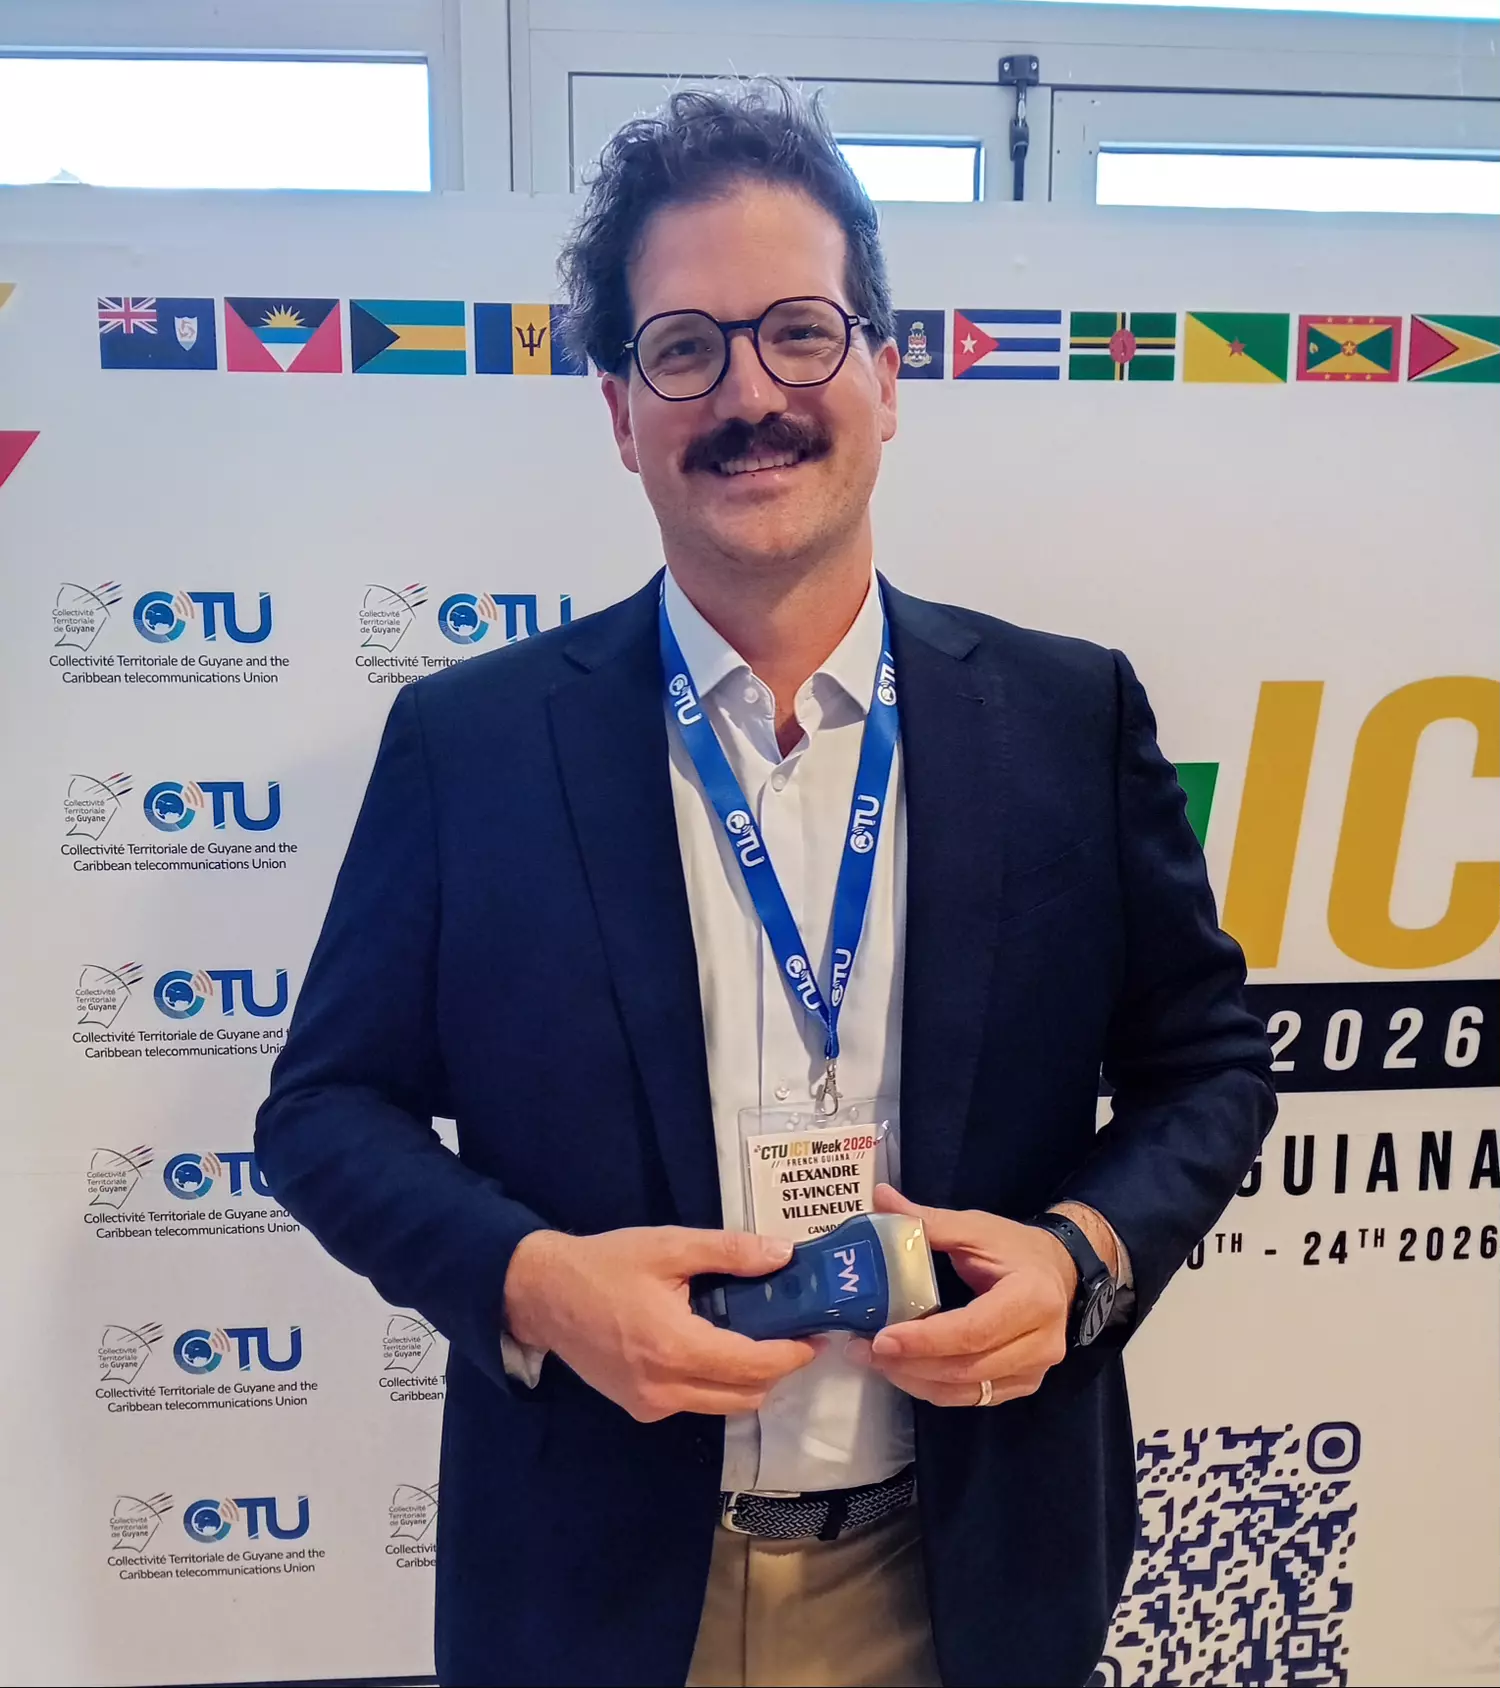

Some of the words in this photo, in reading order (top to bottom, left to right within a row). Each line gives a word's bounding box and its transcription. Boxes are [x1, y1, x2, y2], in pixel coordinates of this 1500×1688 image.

[133, 591, 272, 644] CTU
[54, 625, 63, 633] de
[66, 625, 95, 633] Guyane
[372, 626, 400, 635] Guyane
[50, 655, 114, 666] Collectivité
[117, 655, 177, 666] Territoriale
[181, 655, 195, 666] de
[198, 655, 242, 670] Guyane
[245, 655, 267, 666] and
[270, 655, 289, 666] the
[355, 656, 418, 667] Collectivité
[421, 656, 465, 667] Territor
[62, 672, 121, 683] Caribbean
[125, 672, 240, 683] telecommunications
[243, 672, 278, 683] Union
[669, 673, 702, 726] CTU
[144, 781, 281, 832] CTU
[65, 815, 75, 823] de
[77, 814, 105, 823] Guyane
[849, 795, 880, 854] CTU
[726, 809, 765, 868] CTU
[61, 844, 124, 855] Collectivité
[127, 844, 187, 855] Territoriale
[191, 843, 204, 854] de
[208, 843, 250, 857] Guyane
[254, 842, 276, 853] and
[279, 842, 297, 853] the
[73, 860, 131, 871] Caribbean
[135, 859, 249, 871] telecommunications
[252, 858, 286, 869] Union
[785, 954, 820, 1011] CTU
[831, 948, 851, 1008] CTU
[154, 969, 288, 1019] CTU
[88, 1003, 116, 1012] Guyane
[73, 1032, 135, 1043] Collectivité
[138, 1031, 197, 1042] Territoriale
[200, 1030, 214, 1040] de
[217, 1029, 260, 1043] Guyane
[263, 1029, 283, 1040] and
[1267, 1005, 1486, 1073] 2026
[85, 1048, 141, 1058] Caribbean
[145, 1046, 257, 1057] telecommunications
[260, 1044, 286, 1055] Uni
[761, 1145, 787, 1161] CTU
[788, 1141, 811, 1157] ICT
[812, 1140, 841, 1155] Week
[843, 1136, 872, 1151] 2026
[787, 1157, 818, 1167] FRENCH
[821, 1153, 849, 1163] GUIANA
[780, 1164, 859, 1184] ALEXANDRE
[99, 1185, 127, 1193] Guyane
[782, 1182, 860, 1201] ST-VINCENT
[84, 1213, 145, 1224] Collectivité
[148, 1211, 205, 1222] Territoriale
[209, 1210, 222, 1220] de
[225, 1209, 267, 1223] Guyane
[782, 1200, 863, 1219] VILLENEUVE
[96, 1228, 151, 1239] Caribbean
[155, 1225, 264, 1237] telecommunications
[268, 1223, 300, 1234] Union
[808, 1224, 841, 1234] CANAD
[1399, 1225, 1497, 1262] 2026
[834, 1248, 859, 1293] PW
[173, 1326, 302, 1374] CTU
[111, 1361, 138, 1369] Guyane
[379, 1376, 438, 1387] Collectivité
[95, 1387, 156, 1399] Collectivité
[159, 1385, 215, 1396] Territoriale
[218, 1384, 231, 1394] de
[234, 1383, 275, 1396] Guyane
[278, 1382, 297, 1392] and
[300, 1381, 318, 1391] the
[390, 1390, 444, 1401] Caribbean
[108, 1401, 162, 1413] Caribbean
[165, 1398, 273, 1411] telecommunications
[276, 1396, 307, 1406] Union
[183, 1496, 310, 1543] CTU
[122, 1530, 148, 1538] Guyane
[386, 1544, 437, 1554] Collectivit
[108, 1555, 166, 1567] Collectivité
[170, 1553, 224, 1564] Territoriale
[227, 1552, 239, 1562] de
[242, 1551, 283, 1565] Guyane
[286, 1550, 305, 1559] and
[308, 1548, 325, 1558] the
[397, 1558, 436, 1568] Caribbe
[120, 1569, 172, 1580] Caribbean
[175, 1565, 281, 1578] telecommunications
[284, 1563, 315, 1573] Union
